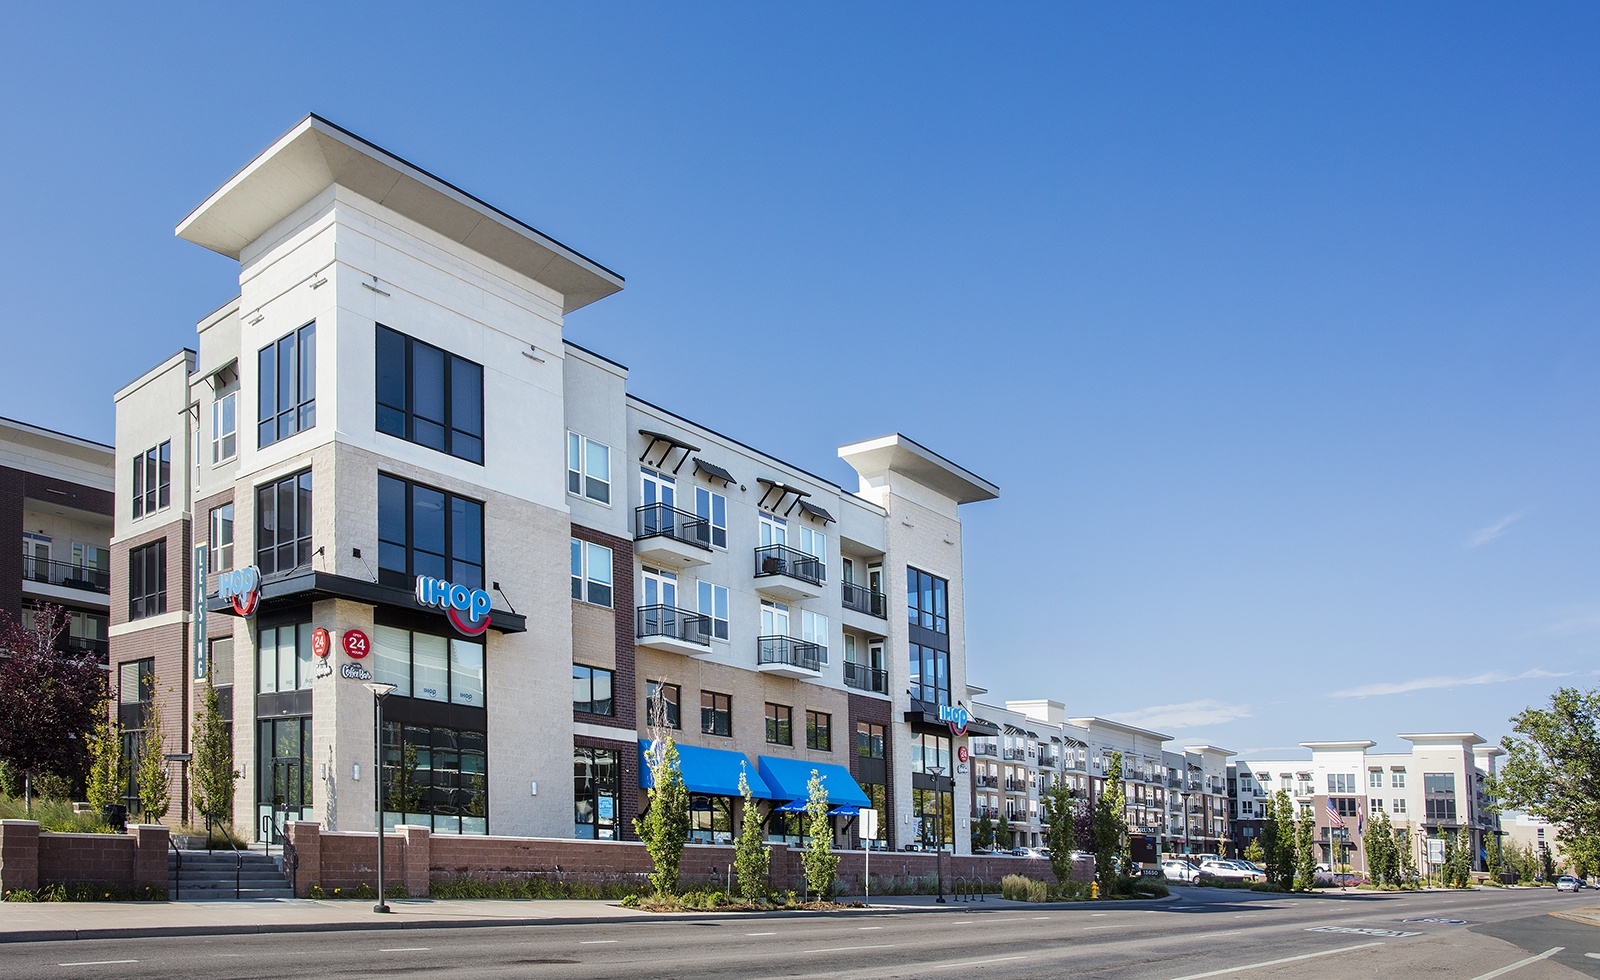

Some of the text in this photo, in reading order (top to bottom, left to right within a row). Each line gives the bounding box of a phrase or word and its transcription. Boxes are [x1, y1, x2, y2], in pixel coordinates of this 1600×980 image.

[218, 566, 257, 603] IHOP
[420, 577, 491, 622] IHOP
[315, 635, 324, 648] 24
[349, 637, 366, 650] 24
[939, 705, 967, 729] IHOP
